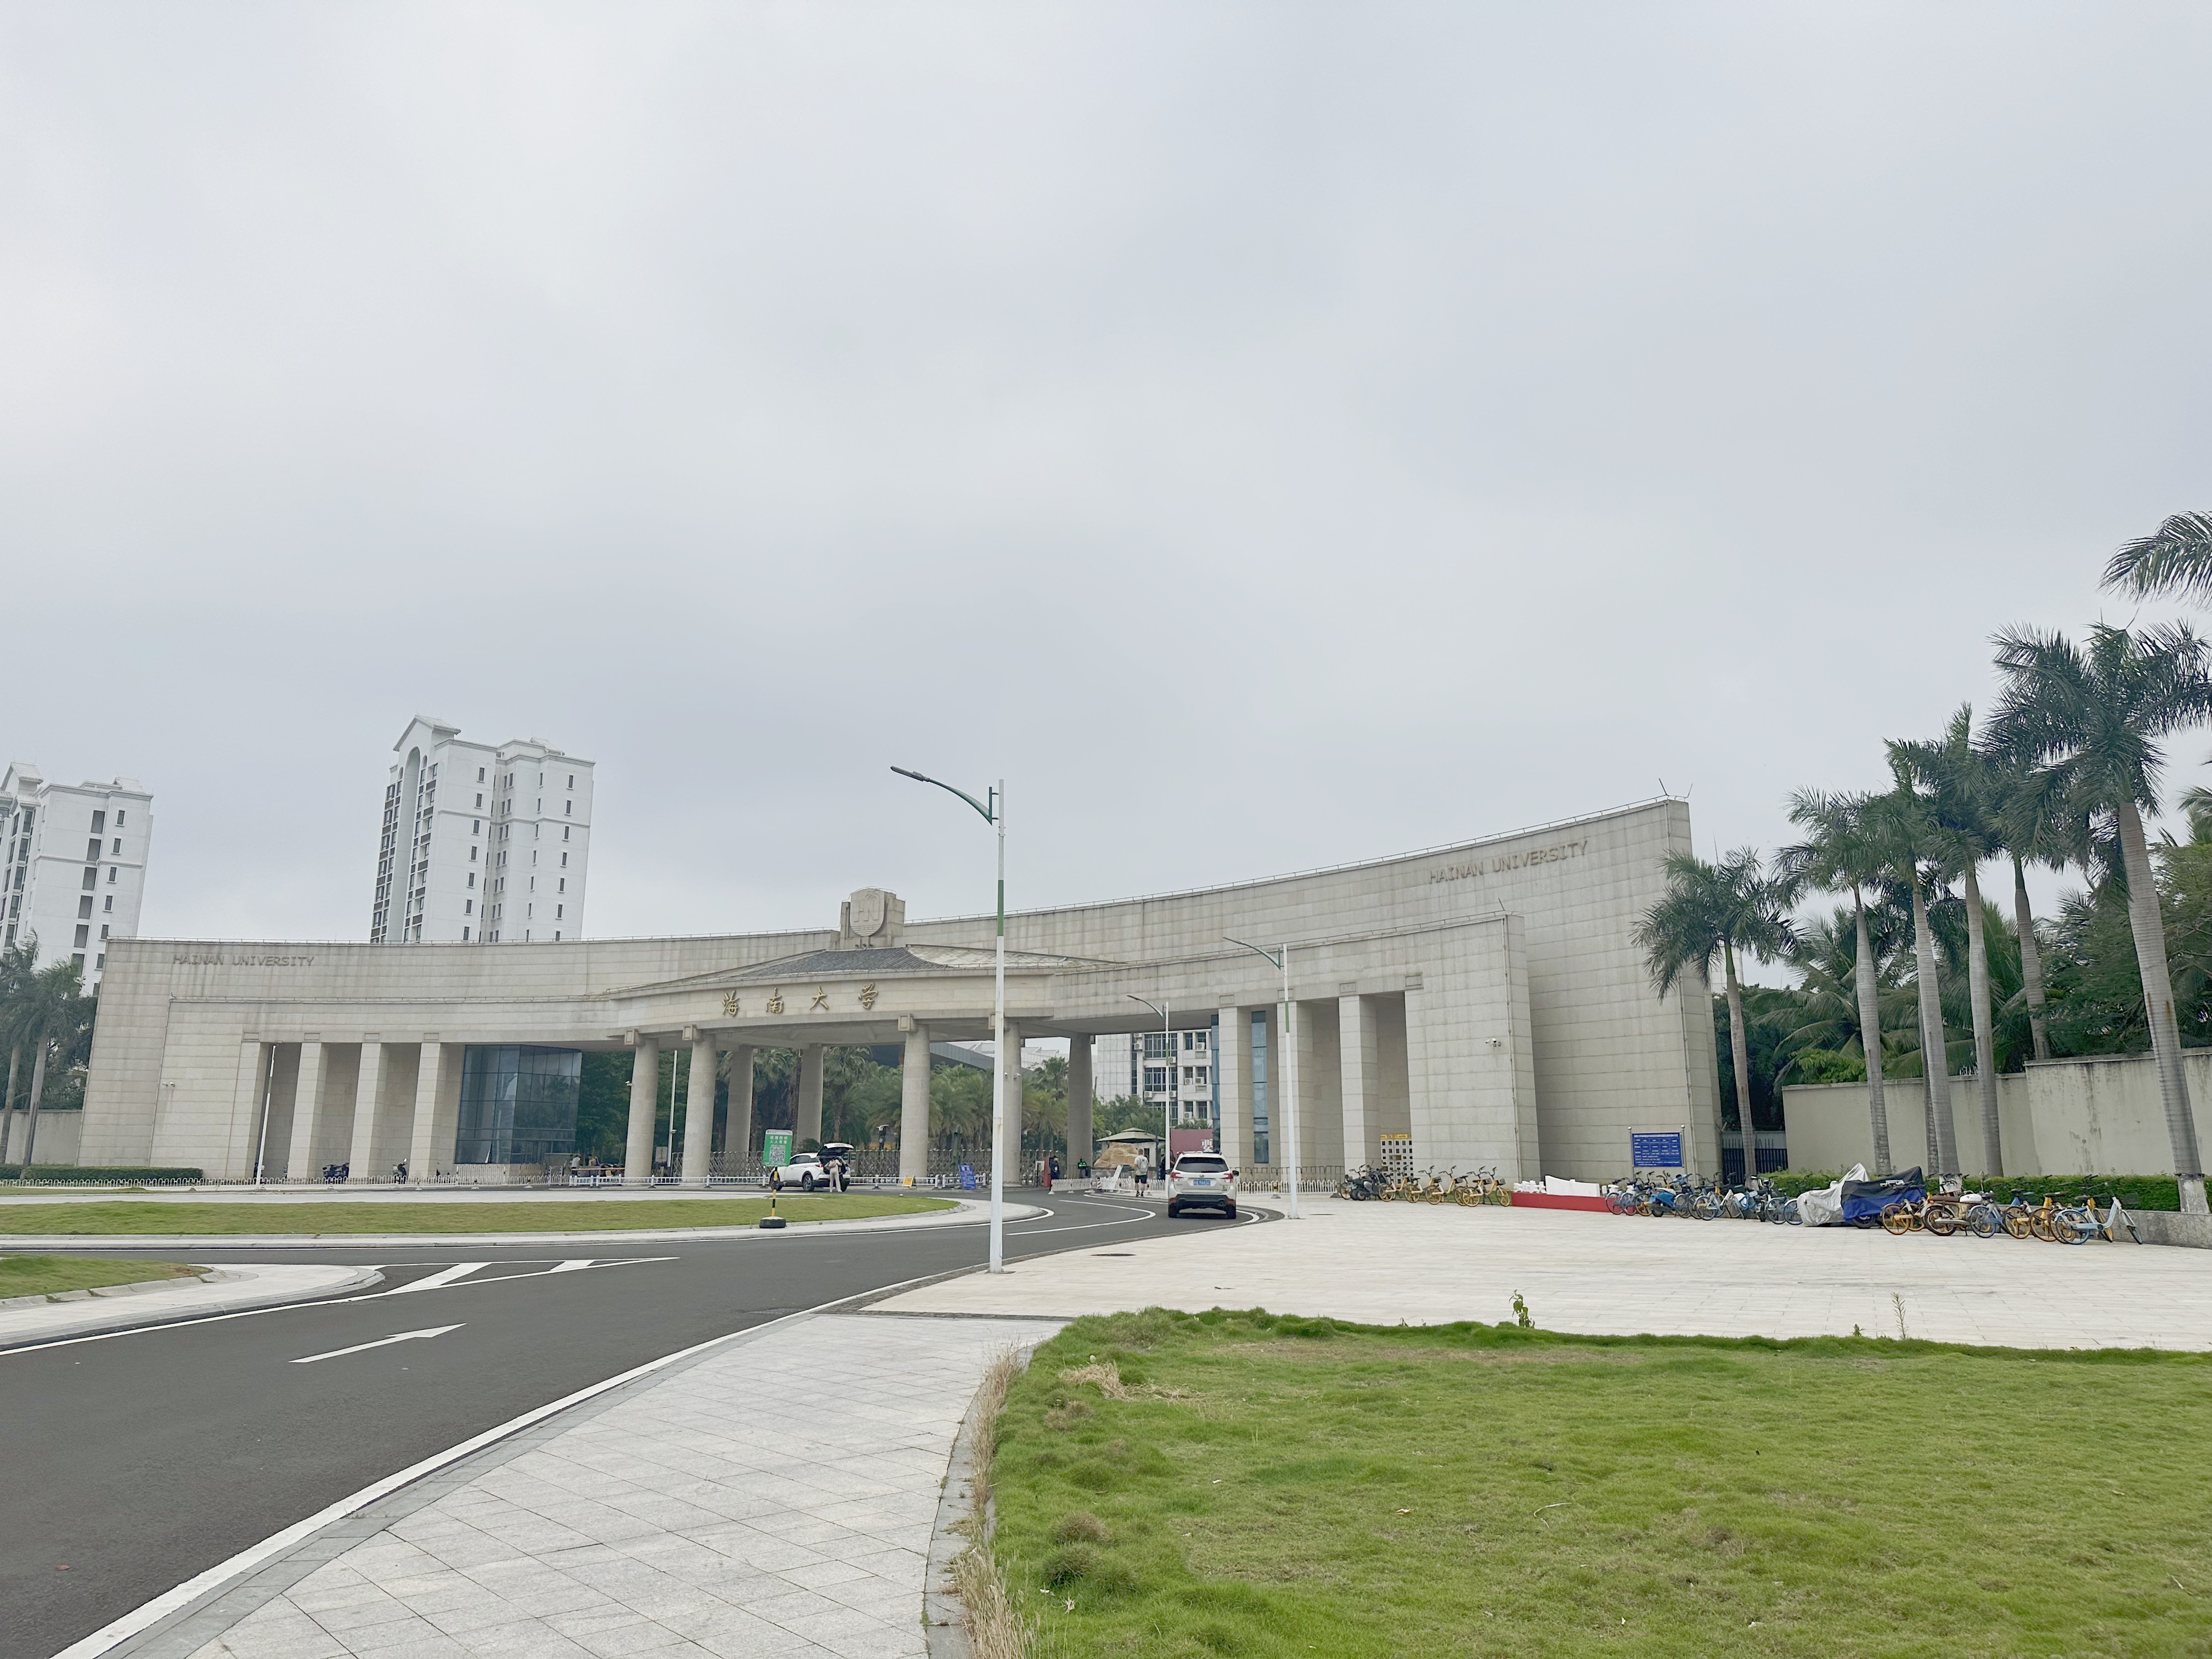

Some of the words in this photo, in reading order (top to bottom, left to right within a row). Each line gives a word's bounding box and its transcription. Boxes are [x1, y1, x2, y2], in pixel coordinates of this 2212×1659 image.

[1429, 862, 1483, 884] HAINAN
[1492, 840, 1588, 873] UNIVERSITY
[173, 954, 225, 965] HAINAN
[232, 955, 315, 967] UNIVERSITY
[721, 982, 878, 1017] 海南大学
